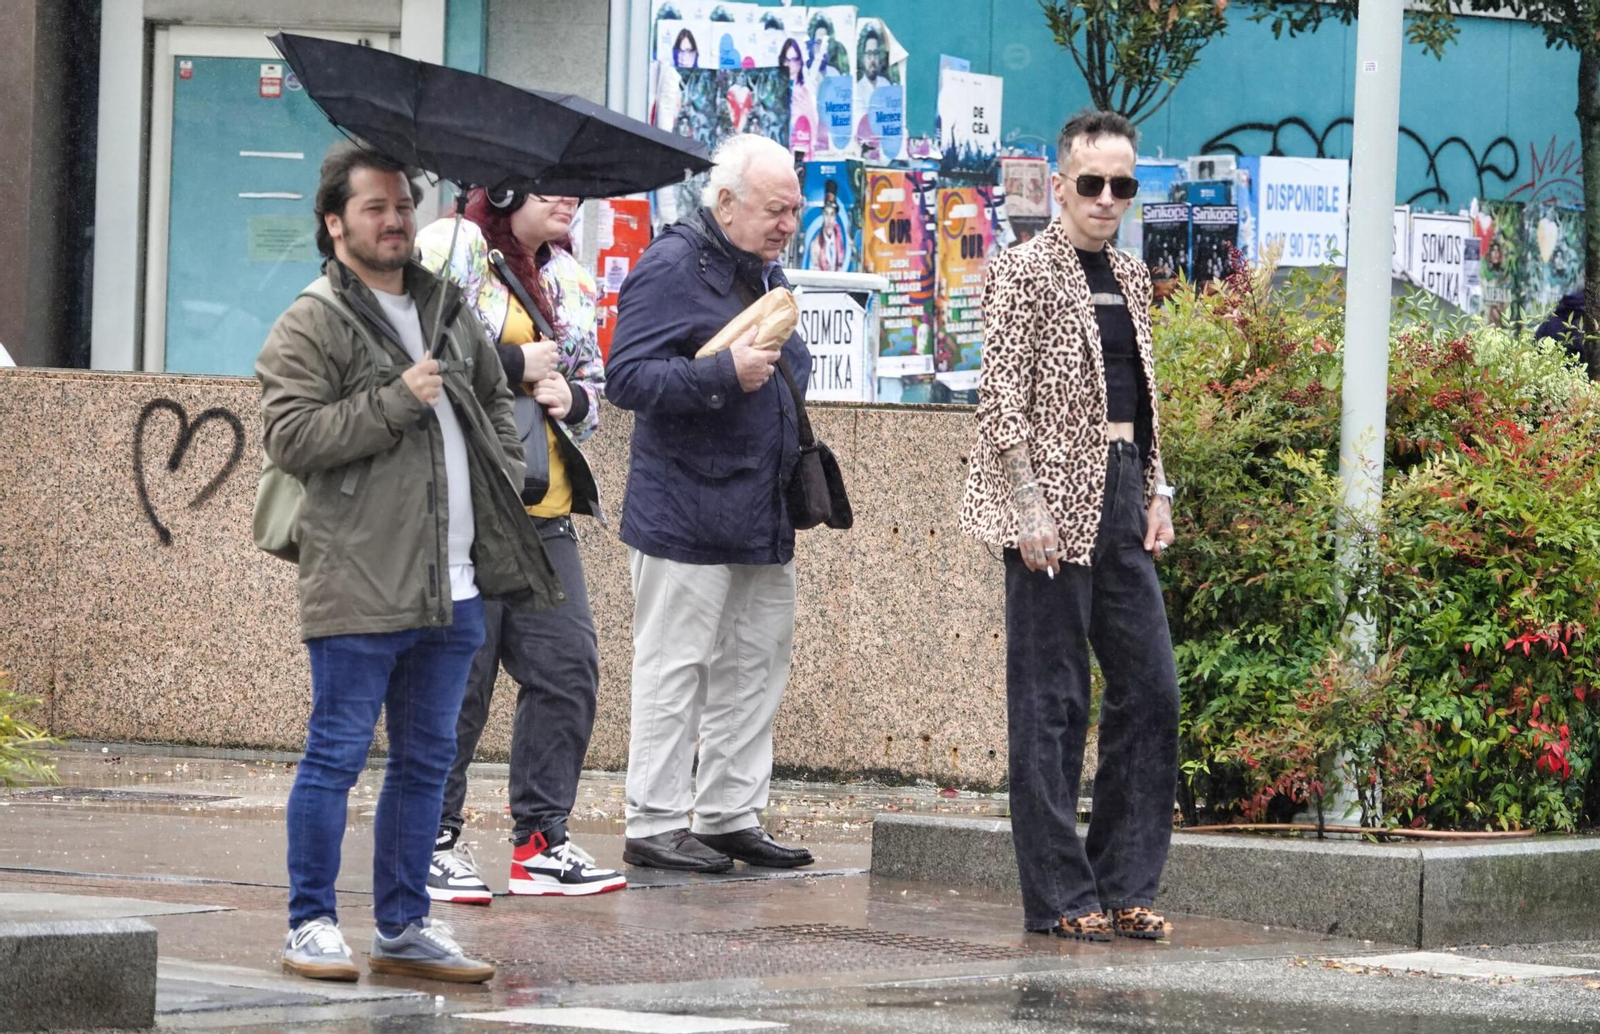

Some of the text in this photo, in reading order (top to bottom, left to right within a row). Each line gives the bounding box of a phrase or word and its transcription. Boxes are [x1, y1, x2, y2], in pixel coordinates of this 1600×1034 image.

[825, 101, 851, 112] Merece
[876, 111, 901, 123] Merece
[973, 106, 984, 119] DE
[1266, 183, 1339, 212] DISPONIBLE
[1289, 232, 1303, 258] 90
[1307, 233, 1321, 258] 75
[1421, 233, 1461, 265] SOMOS
[801, 309, 854, 345] SOMOS
